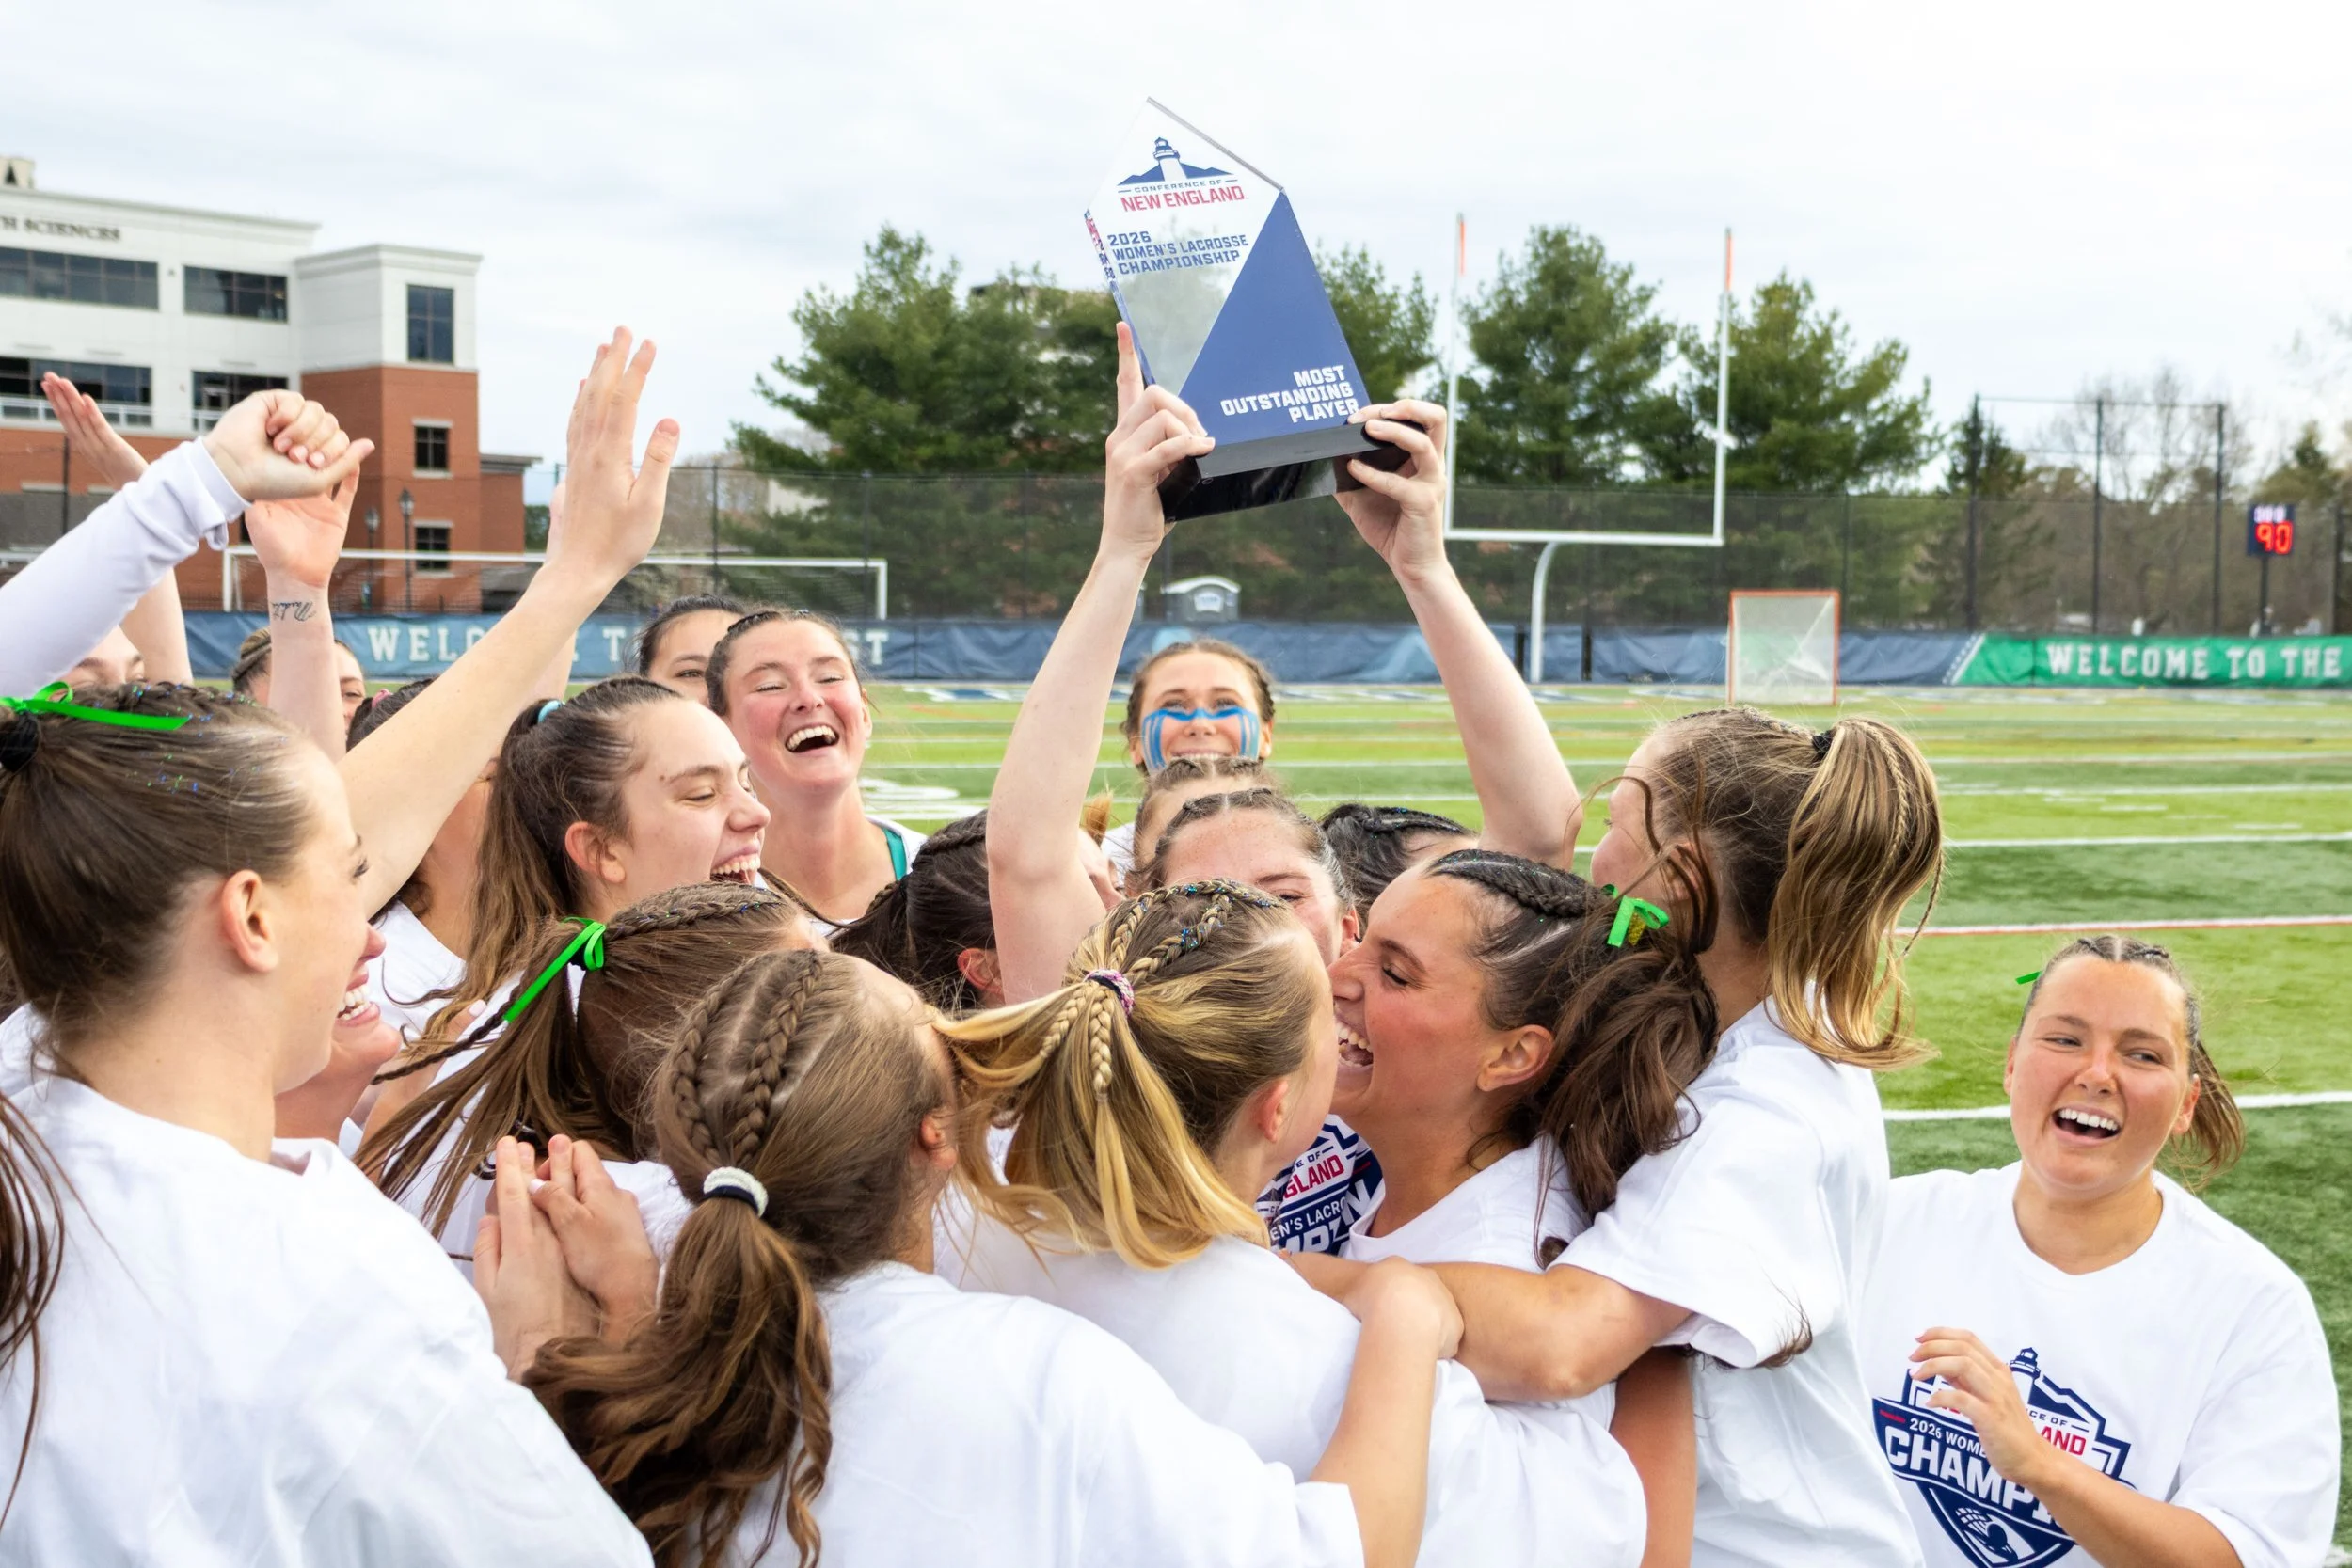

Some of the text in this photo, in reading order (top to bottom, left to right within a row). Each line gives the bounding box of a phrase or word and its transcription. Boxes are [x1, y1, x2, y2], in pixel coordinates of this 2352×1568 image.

[1120, 185, 1246, 212] NEW ENGLAND
[1134, 180, 1206, 193] CONFERENCE
[24, 218, 120, 241] SCIENCES
[1107, 231, 1152, 246] 2026
[1112, 235, 1248, 261] WOMEN'S LACROSSE
[1119, 250, 1240, 275] CHAMPIONSHIP
[1293, 365, 1344, 387] MOST
[1220, 381, 1354, 416] OUTSTANDING
[1288, 398, 1359, 423] PLAYER
[2256, 520, 2293, 554] 90
[2045, 642, 2343, 680] WELCOME TO THE
[1307, 1150, 1320, 1163] OF
[1283, 1154, 1344, 1198] GLAND
[1271, 1218, 1303, 1242] EN'S
[1910, 1418, 1942, 1439] 2026
[2050, 1417, 2068, 1426] OF
